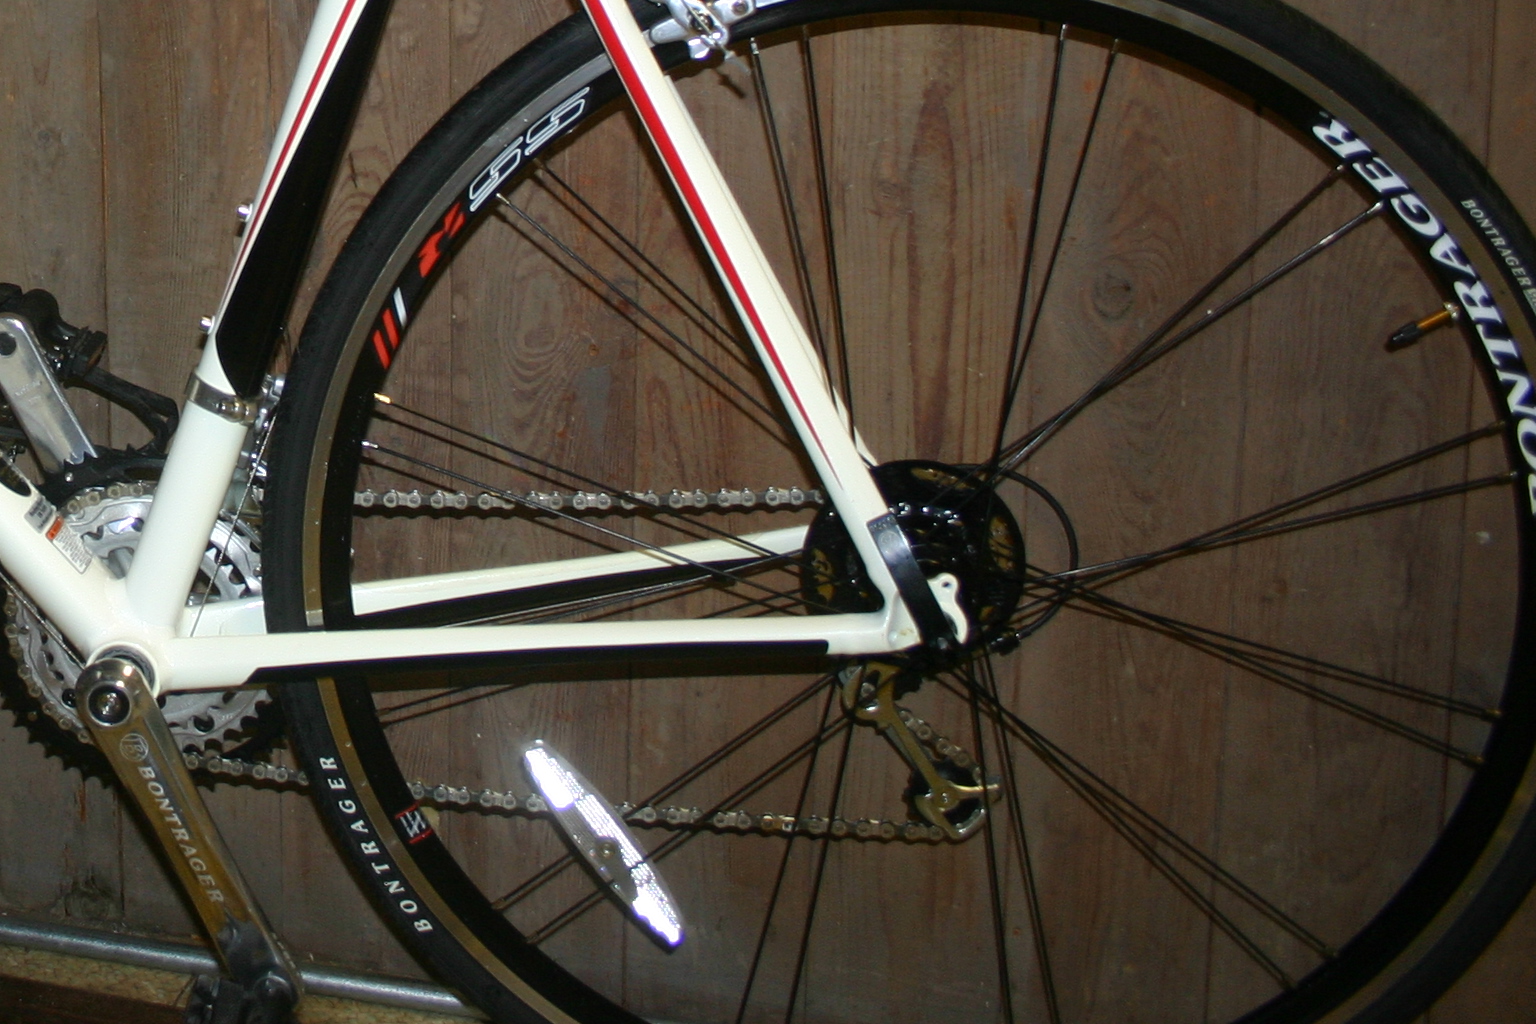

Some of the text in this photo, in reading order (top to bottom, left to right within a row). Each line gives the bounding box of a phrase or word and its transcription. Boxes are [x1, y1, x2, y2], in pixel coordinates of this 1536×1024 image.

[1312, 117, 1536, 520] ONTRAGER
[1460, 198, 1532, 287] BONTRAGER
[137, 765, 225, 904] BONTRAGER
[319, 756, 434, 933] BONTRAGER
